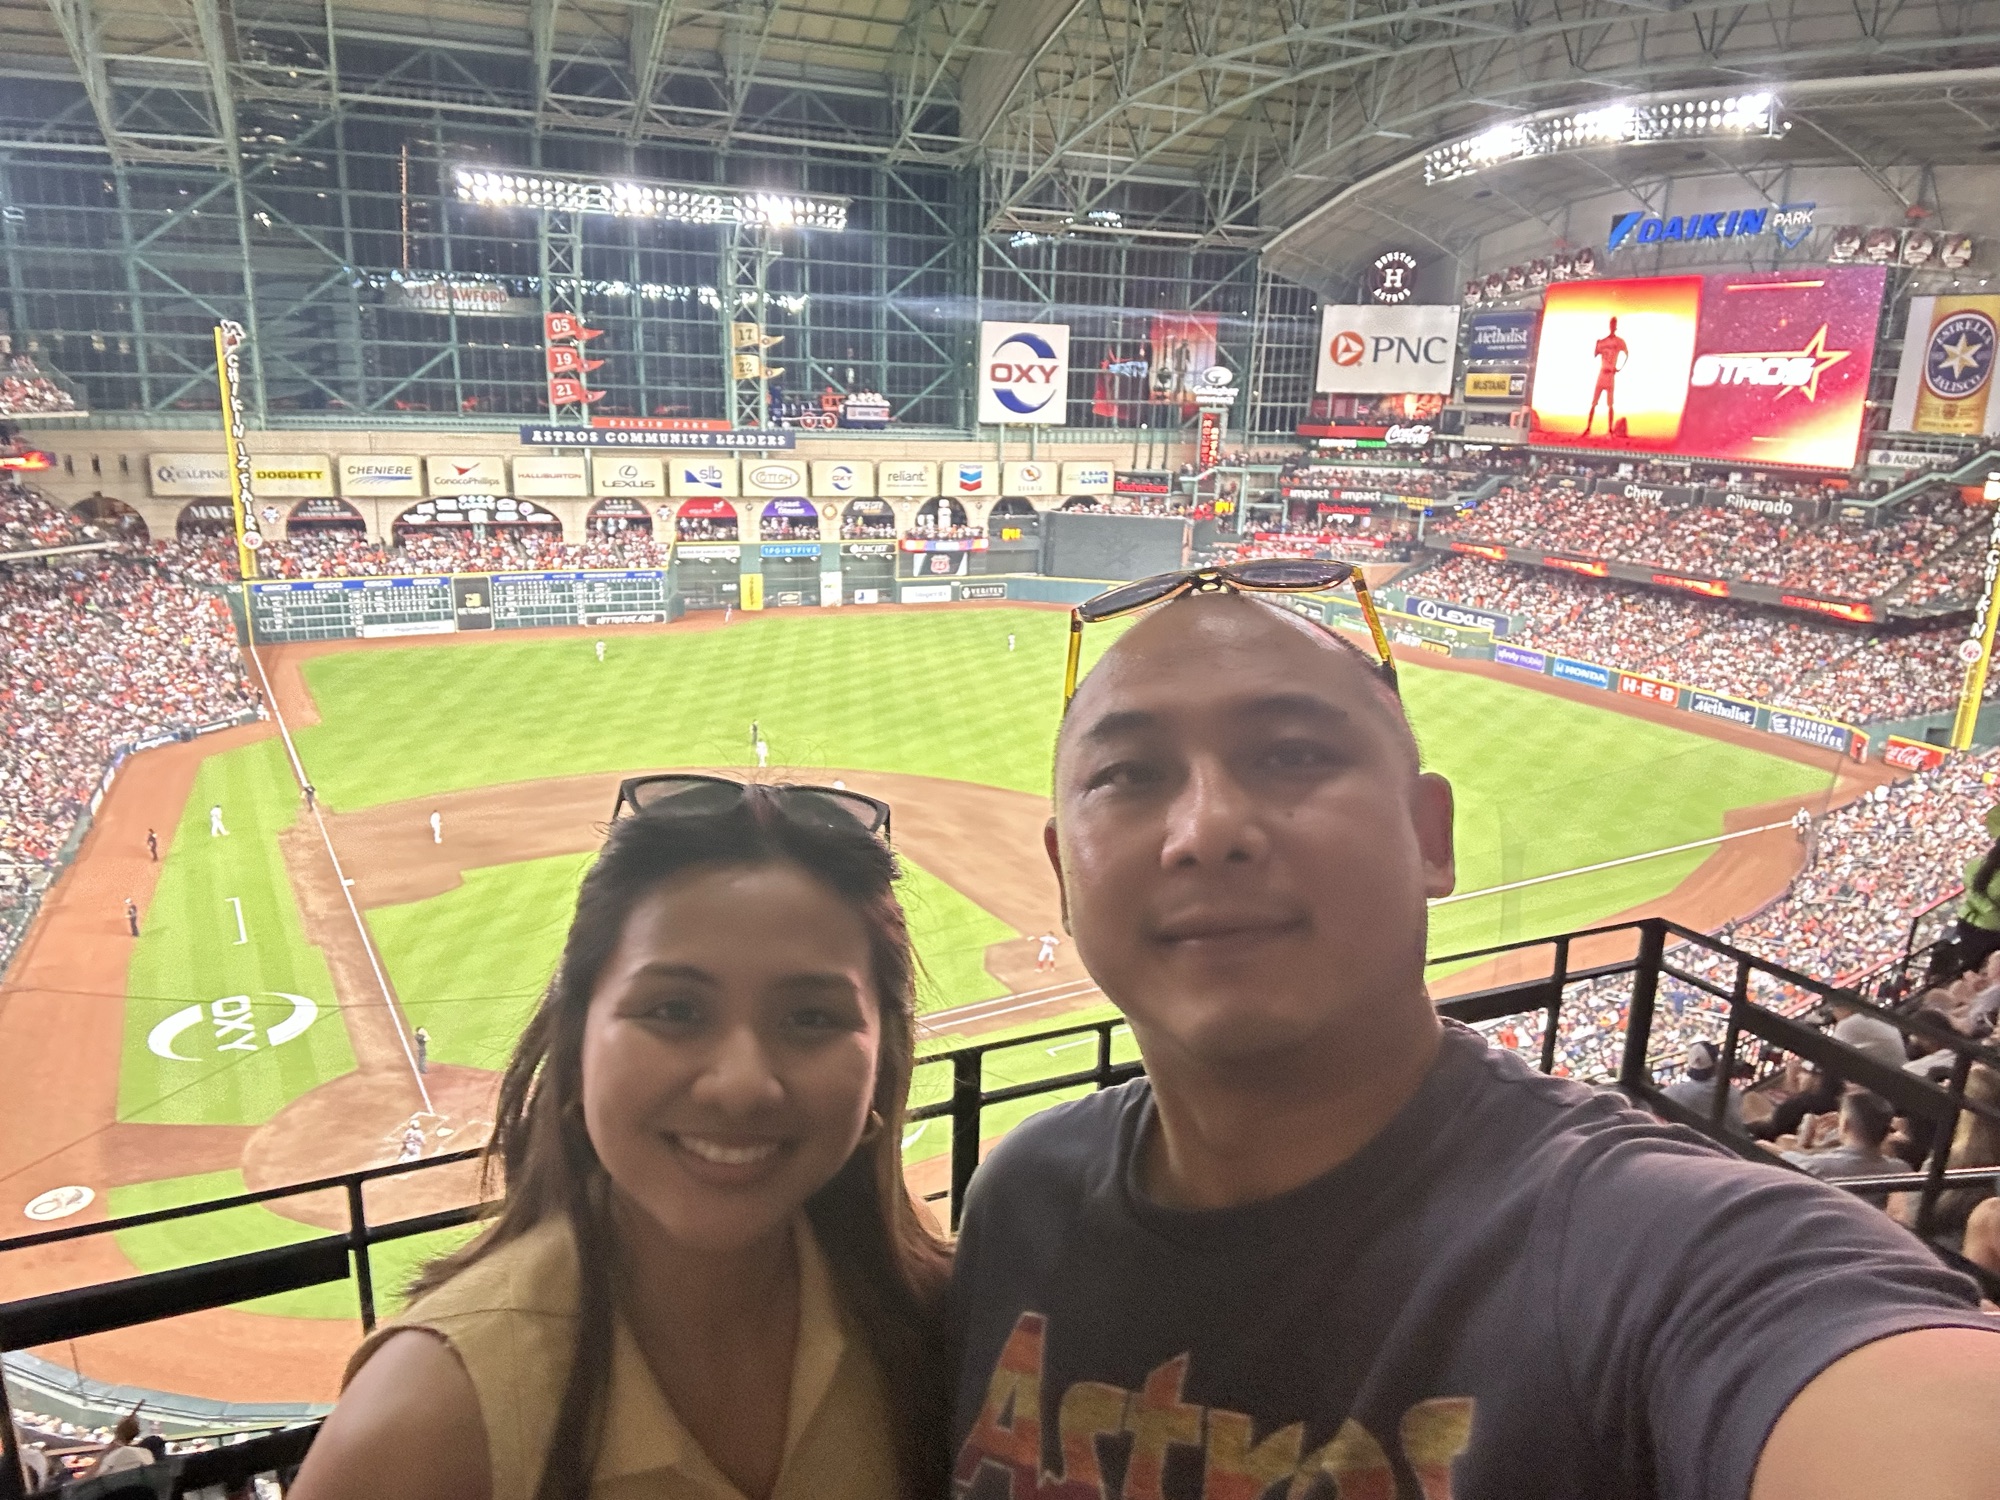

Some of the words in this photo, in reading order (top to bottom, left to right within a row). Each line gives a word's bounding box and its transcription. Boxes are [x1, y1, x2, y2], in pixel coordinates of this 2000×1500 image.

[1637, 208, 1768, 244] DAIKIN
[1773, 210, 1814, 227] PARK
[1383, 268, 1404, 288] H
[1373, 288, 1411, 303] ASTROS
[551, 319, 570, 332] 05
[1936, 319, 1992, 345] ESTRELLA
[738, 328, 753, 341] 17
[1370, 336, 1448, 364] PNC
[555, 352, 573, 366] 19
[738, 361, 753, 374] 22
[990, 363, 1059, 384] OXY
[556, 384, 573, 397] 21
[1932, 374, 1981, 391] JALISCO
[226, 353, 245, 438] CHIKIN
[532, 430, 599, 444] ASTROS
[604, 431, 710, 445] COMMUNITY
[715, 433, 786, 447] LEADERS
[256, 470, 323, 480] DOGGETT
[347, 465, 413, 476] CHENIERE
[699, 465, 723, 481] slb
[434, 475, 500, 486] ConocoPhillips
[601, 480, 656, 488] LEXUS
[1115, 480, 1168, 494] Budweiser
[239, 472, 257, 530] FAIR
[1289, 489, 1329, 500] impact
[1340, 491, 1381, 502] impact
[1624, 484, 1663, 502] Chevy
[1726, 494, 1794, 516] Silverado
[1970, 549, 2000, 640] CHIKIN
[1436, 607, 1495, 629] LEXUS
[1564, 665, 1606, 684] HONDA
[1694, 700, 1752, 723] Methodist
[1789, 716, 1834, 735] ENERGY
[1788, 724, 1843, 748] TRANSFER
[210, 994, 259, 1052] OXY
